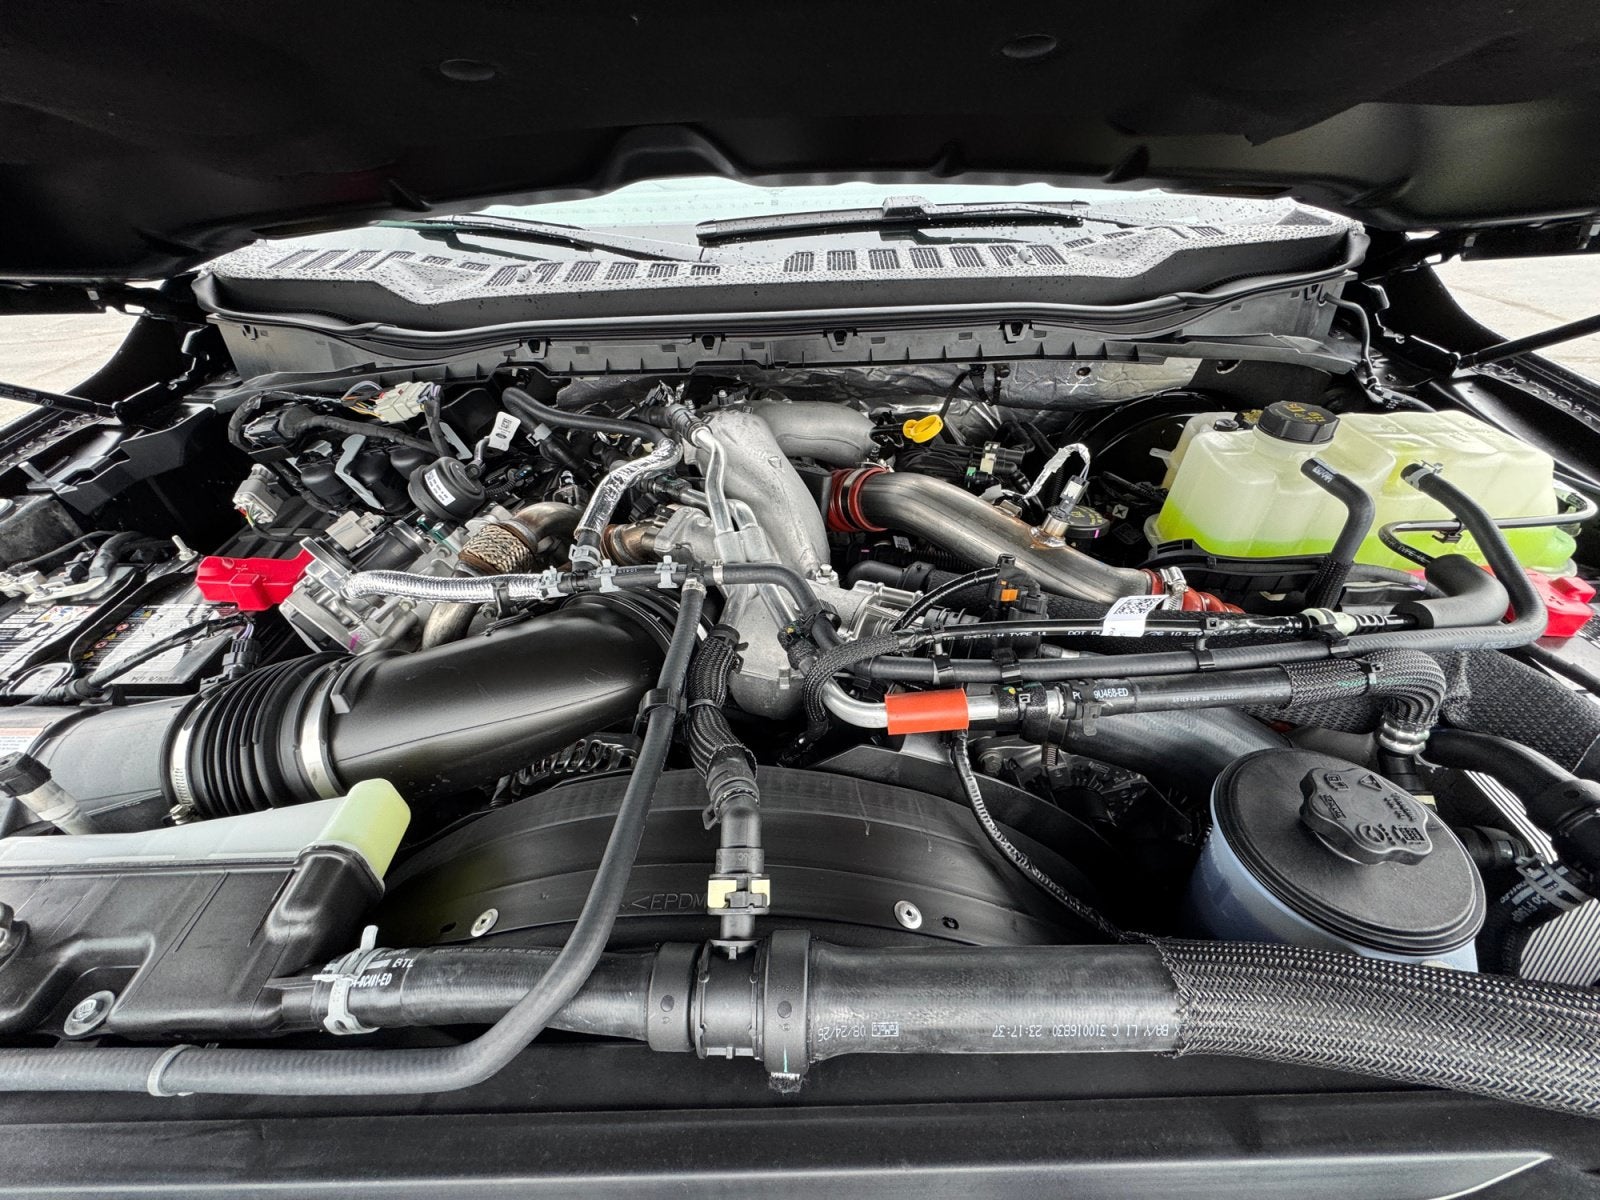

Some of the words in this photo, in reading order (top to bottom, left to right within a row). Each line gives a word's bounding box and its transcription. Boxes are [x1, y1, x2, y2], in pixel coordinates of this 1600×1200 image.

[392, 957, 415, 968] BTL
[992, 1023, 1042, 1038] 23:17:37
[1052, 1023, 1107, 1037] 310016830
